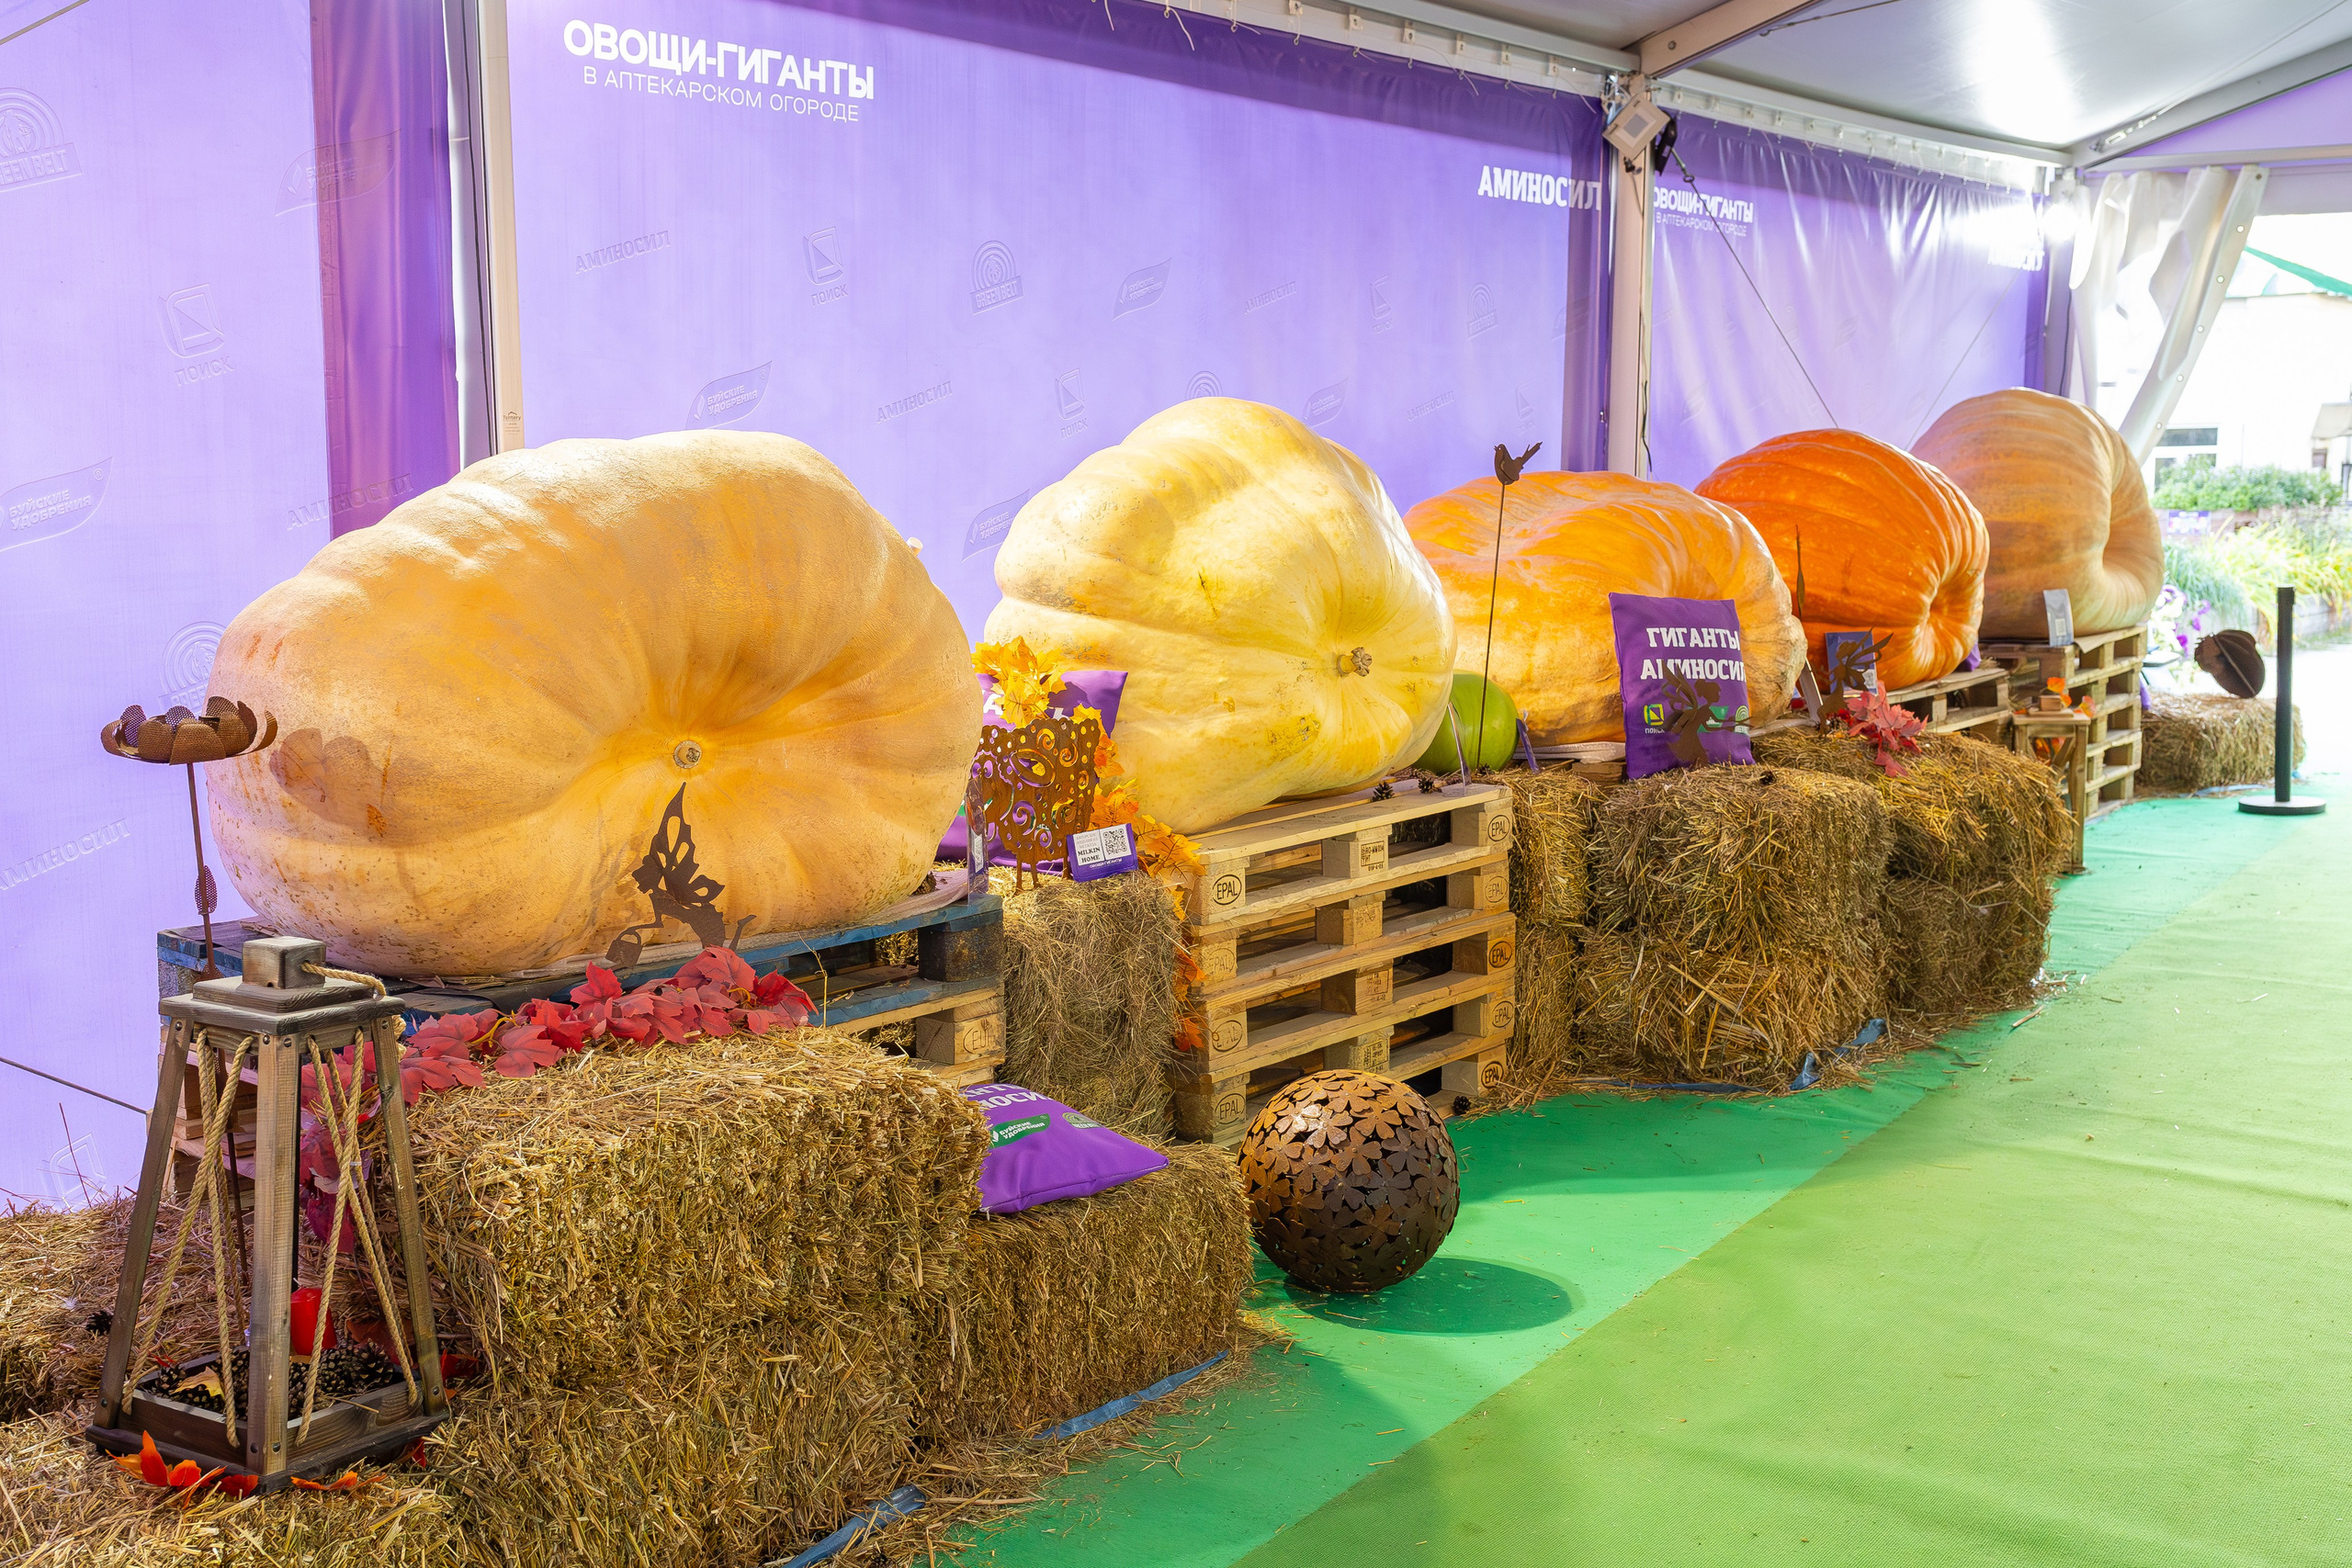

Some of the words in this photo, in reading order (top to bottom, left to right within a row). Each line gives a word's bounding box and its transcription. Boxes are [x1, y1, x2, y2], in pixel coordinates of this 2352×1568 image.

[563, 19, 874, 100] ОВОЩИ-ГИГАНТЫ
[583, 66, 597, 85] В
[605, 69, 762, 108] АПТЕКАРСКОМ
[770, 93, 859, 123] ОГОРОДЕ
[1477, 165, 1601, 211] АМИНОСИЛ
[575, 230, 672, 274] АМИНОСИЛ
[811, 285, 849, 308] ПОИСК
[175, 355, 235, 387] ПОИСК
[876, 380, 954, 424] АМИНОСИЛ
[8, 489, 71, 518] БУЙСКИЕ
[11, 495, 92, 530] УДОБРЕНИЯ
[1646, 627, 1740, 650] ГИГАНТЫ
[1491, 820, 1506, 837] EPAL
[1078, 846, 1101, 857] MILKIN
[1216, 880, 1238, 900] EPAL
[1491, 949, 1509, 964] EPAL
[1494, 1006, 1511, 1023] EPAL
[1484, 1066, 1500, 1084] EPAL
[1219, 1099, 1241, 1120] EPAL
[999, 1121, 1032, 1135] БУЙСКИЕ
[1002, 1122, 1046, 1139] УДОБРЕНИЯ
